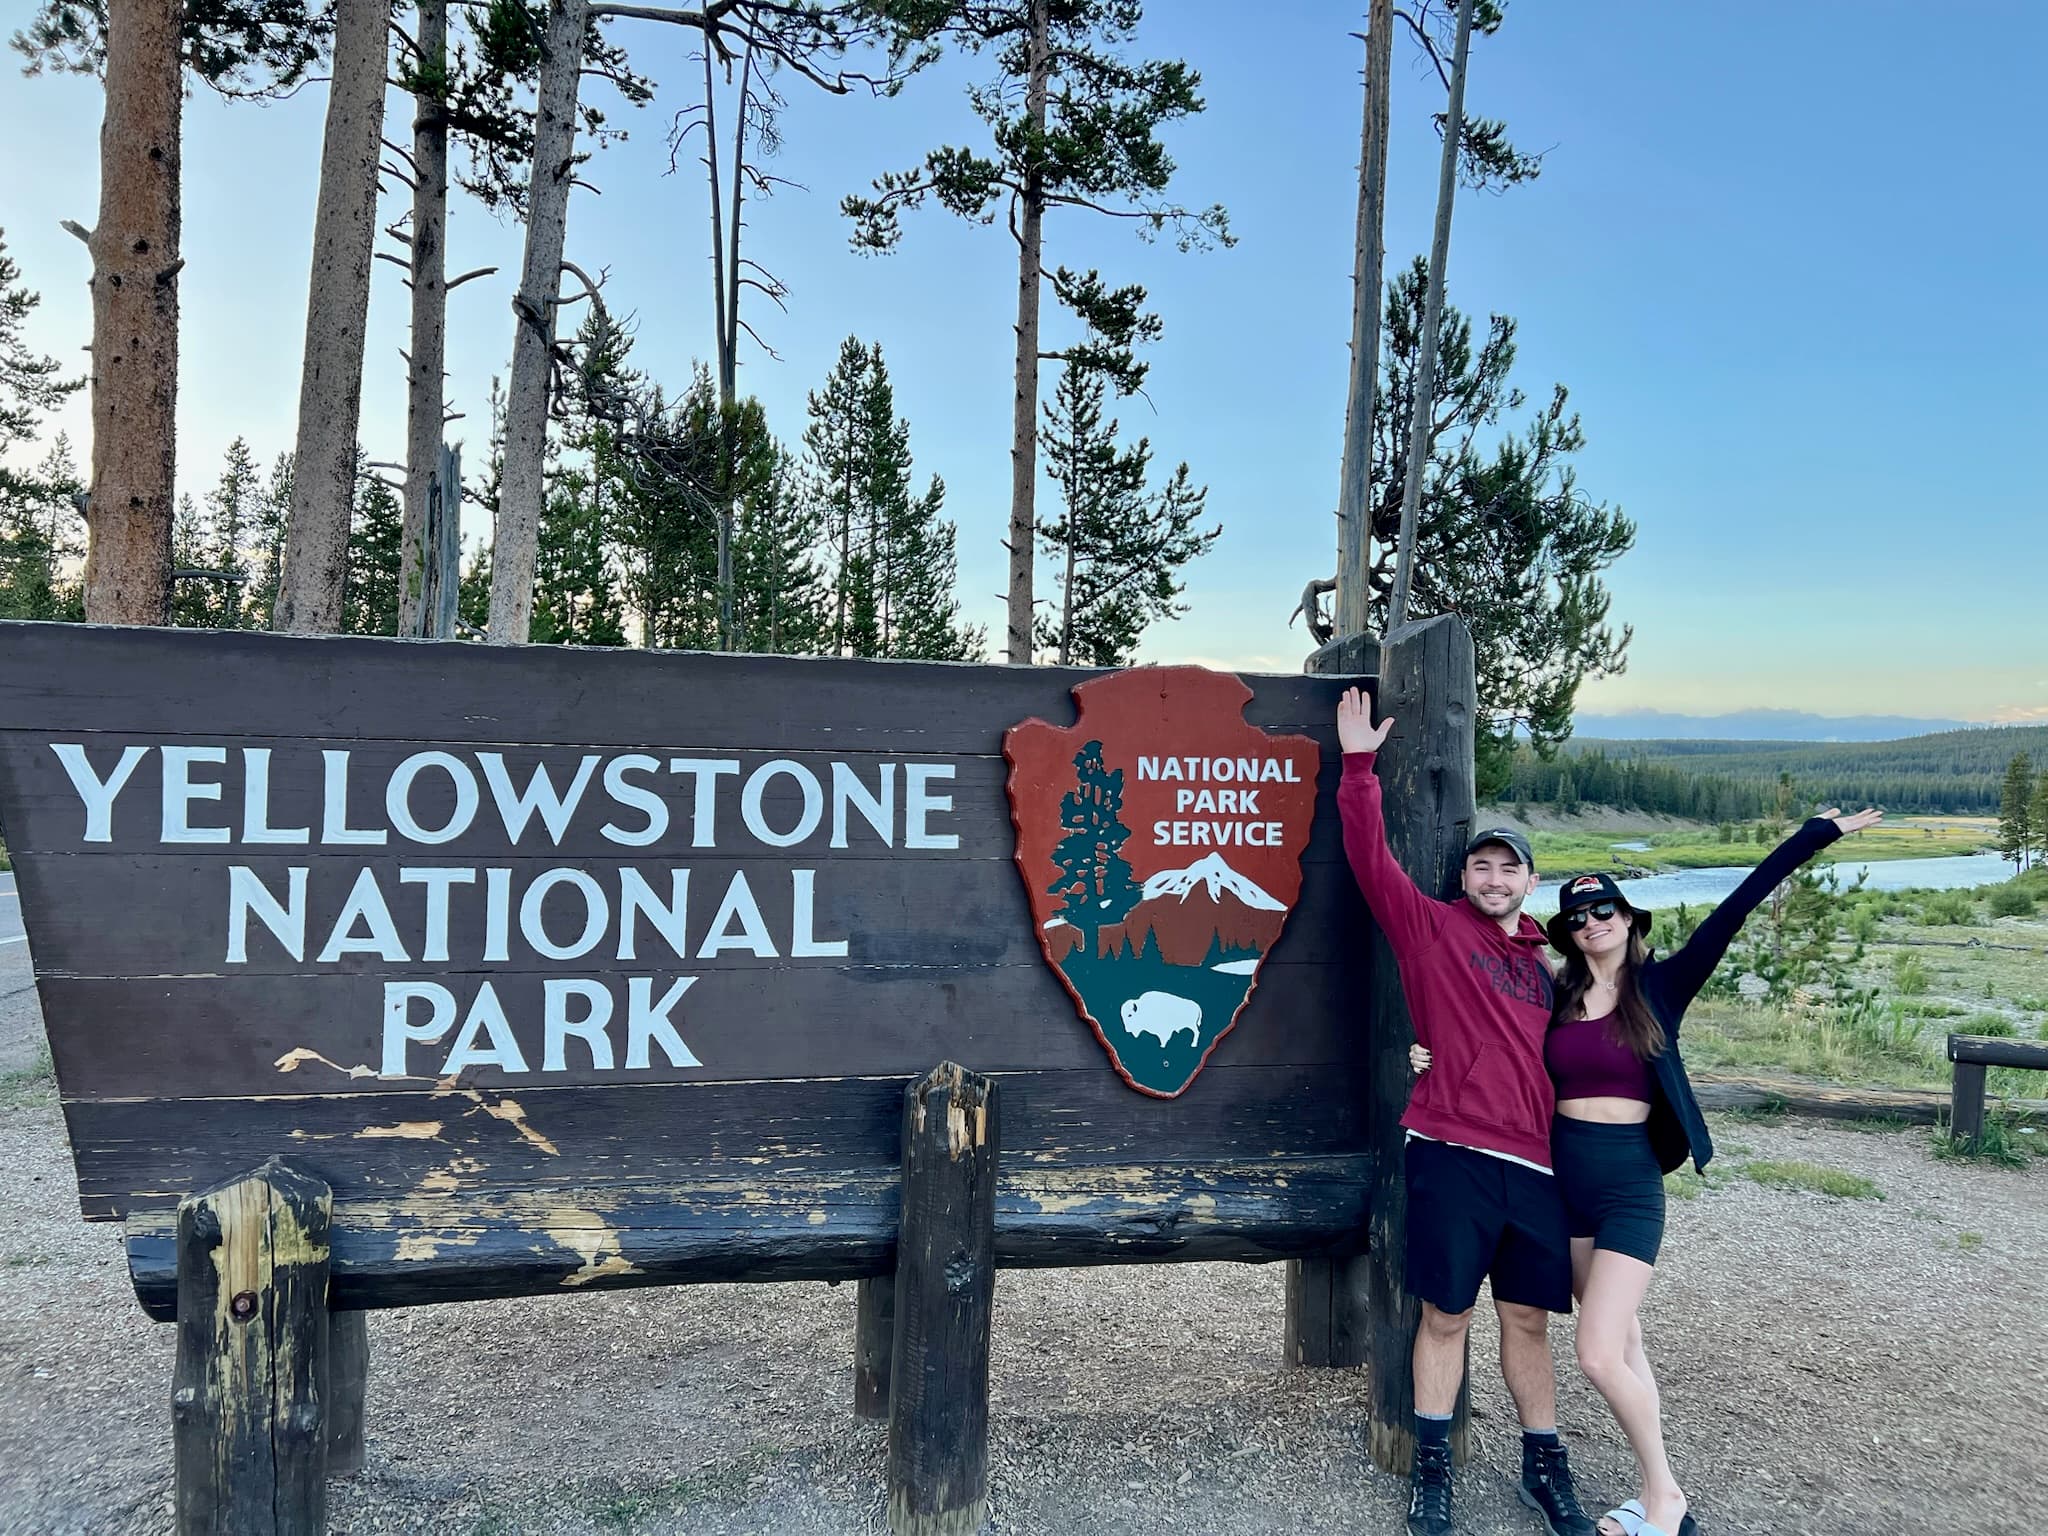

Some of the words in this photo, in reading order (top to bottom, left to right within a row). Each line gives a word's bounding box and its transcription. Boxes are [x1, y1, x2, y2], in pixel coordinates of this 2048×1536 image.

[1138, 757, 1300, 782] NATIONAL
[49, 744, 959, 849] YELLOWSTONE
[1178, 789, 1260, 814] PARK
[1154, 821, 1282, 846] SERVICE
[225, 866, 848, 963] NATIONAL
[1491, 974, 1538, 1005] FACE
[381, 976, 703, 1076] PARK
